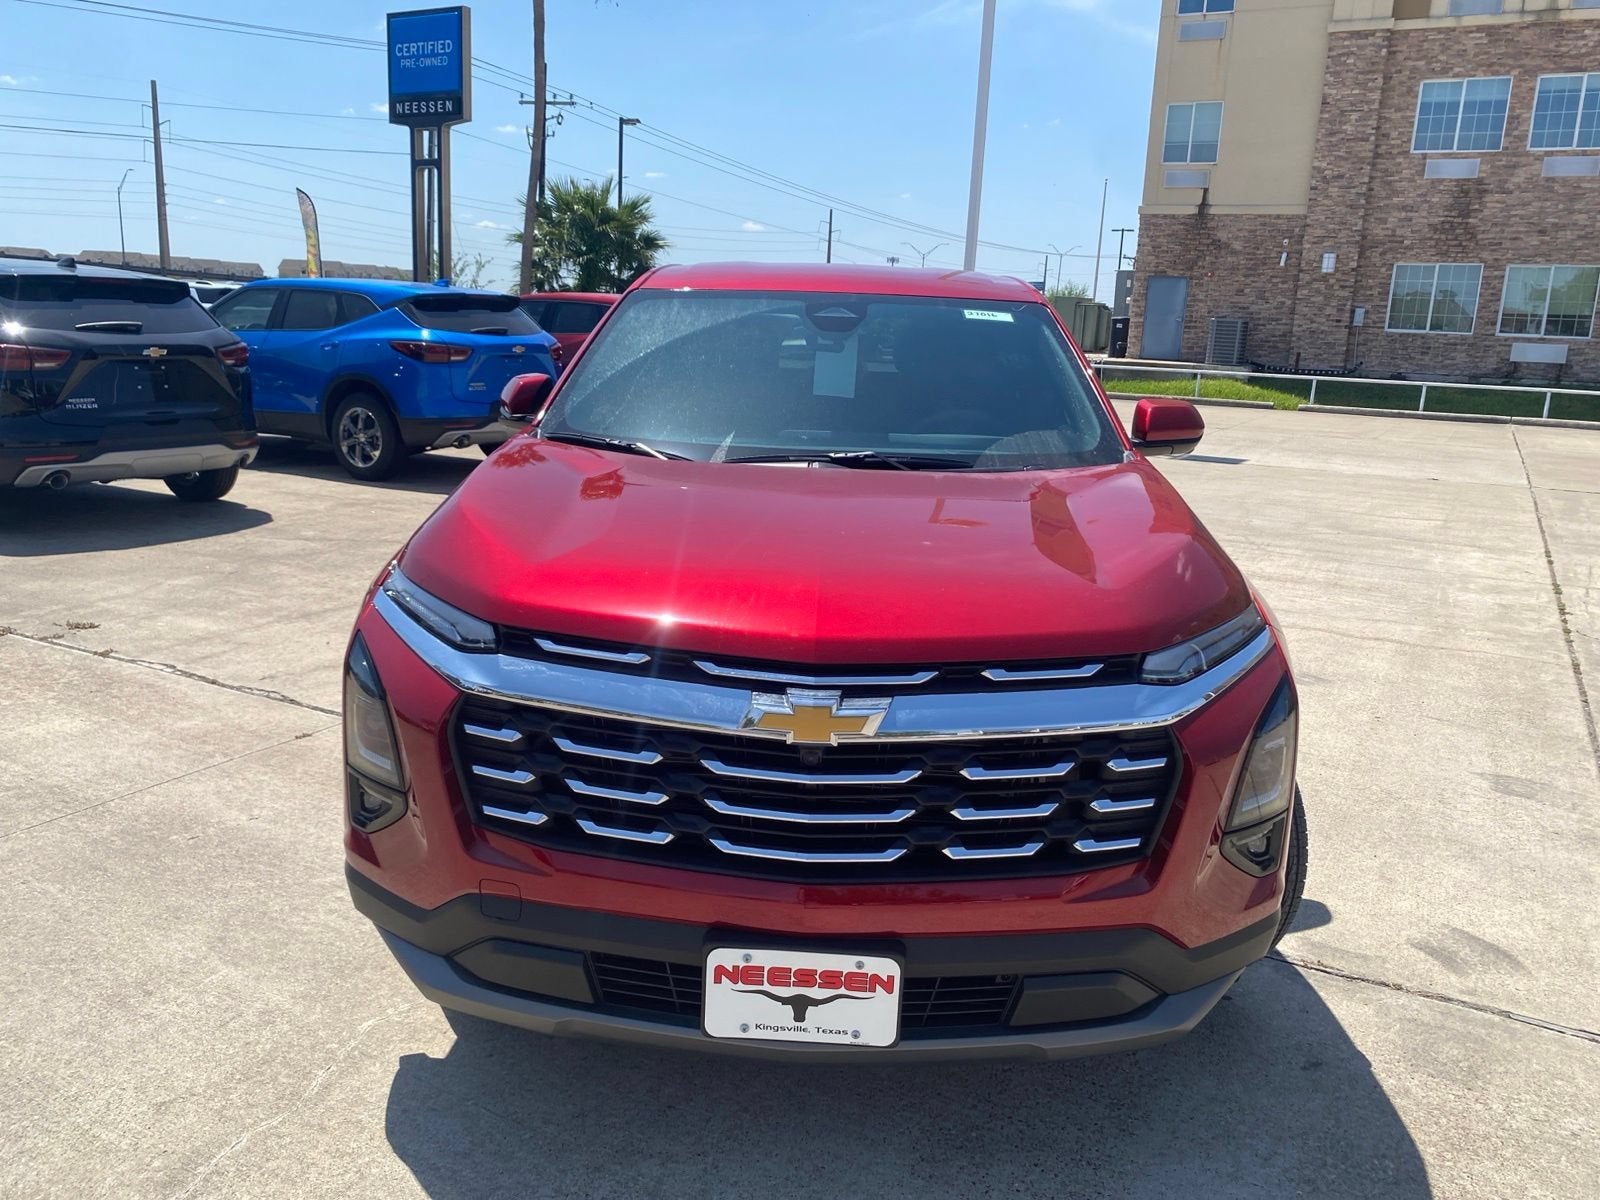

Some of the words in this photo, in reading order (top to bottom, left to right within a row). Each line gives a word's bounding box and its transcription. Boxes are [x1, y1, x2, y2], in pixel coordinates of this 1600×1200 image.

[395, 40, 453, 57] CERTIFIED
[400, 56, 448, 69] PRE-OWNED
[396, 100, 453, 114] NEESSEN
[713, 964, 895, 995] NEESSEN
[755, 1023, 811, 1034] Kingsville,
[815, 1026, 849, 1036] Texas
